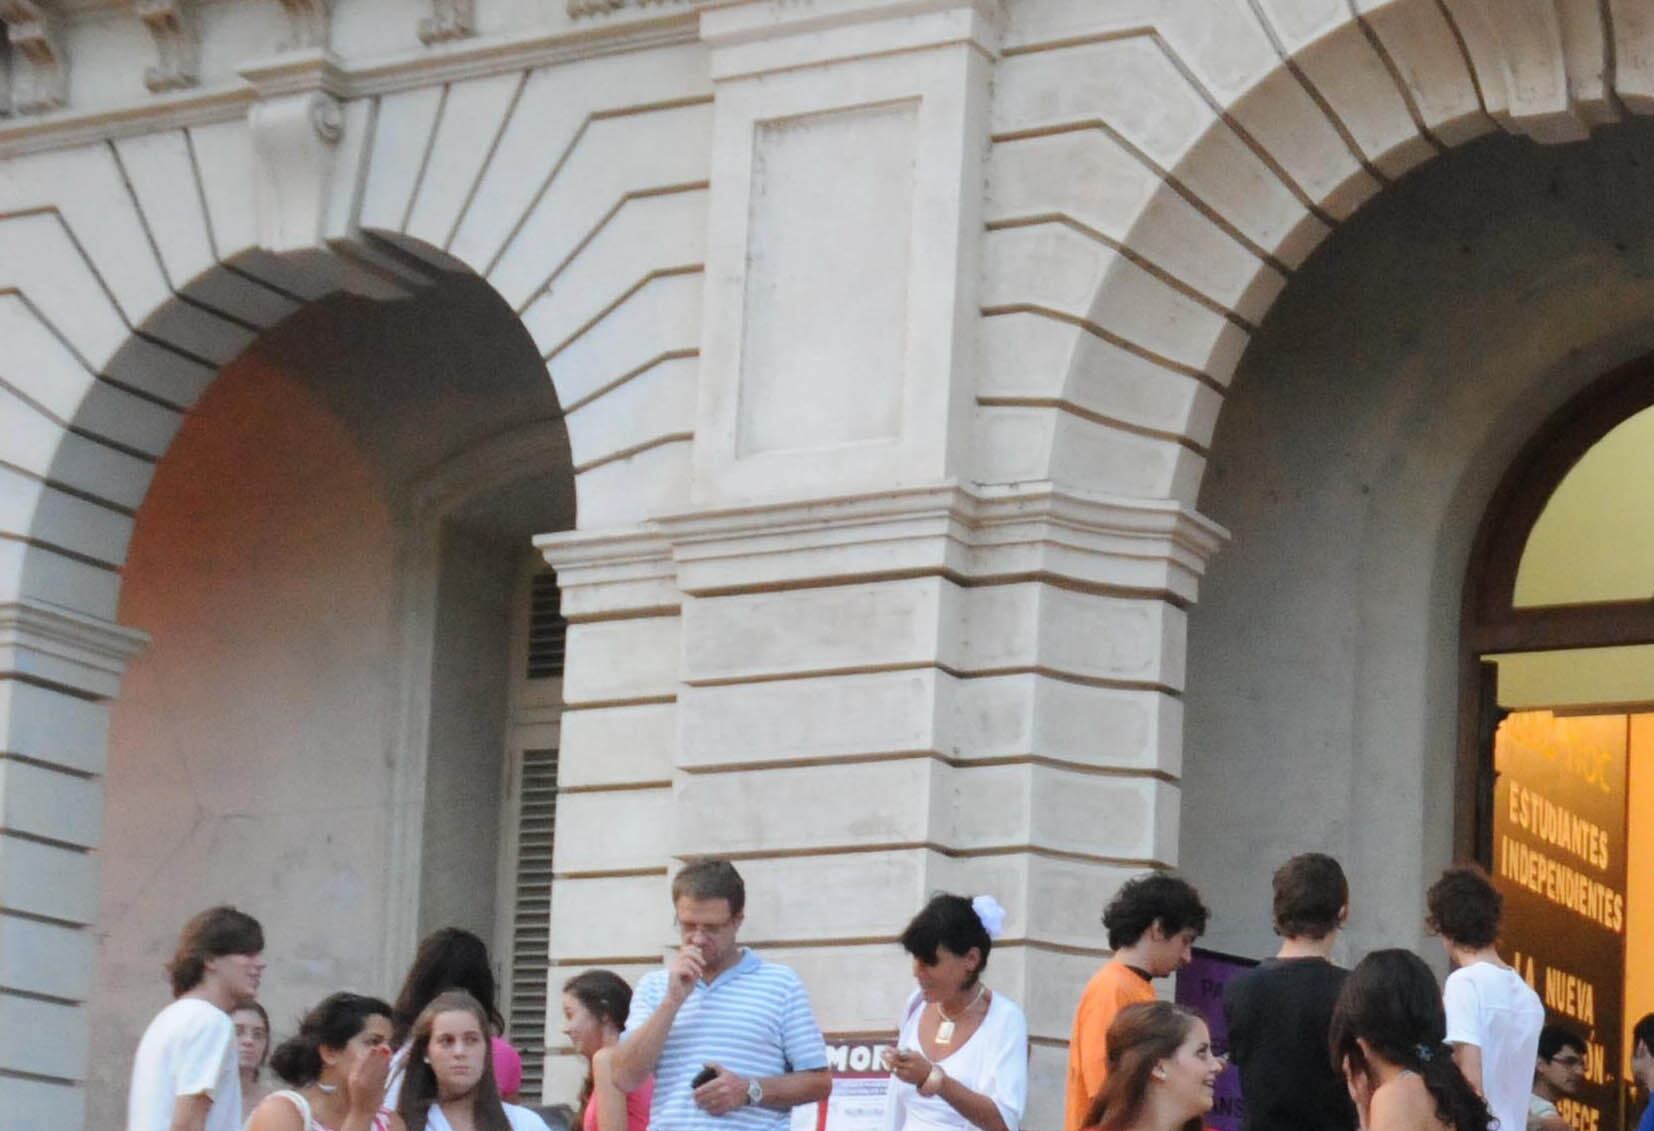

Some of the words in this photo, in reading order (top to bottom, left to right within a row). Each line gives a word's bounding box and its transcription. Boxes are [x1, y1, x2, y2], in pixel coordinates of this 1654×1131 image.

[1509, 779, 1609, 870] ESTUDIANTES
[1501, 834, 1624, 932] INDEPENDIENTES
[1545, 966, 1595, 1026] NUEVA
